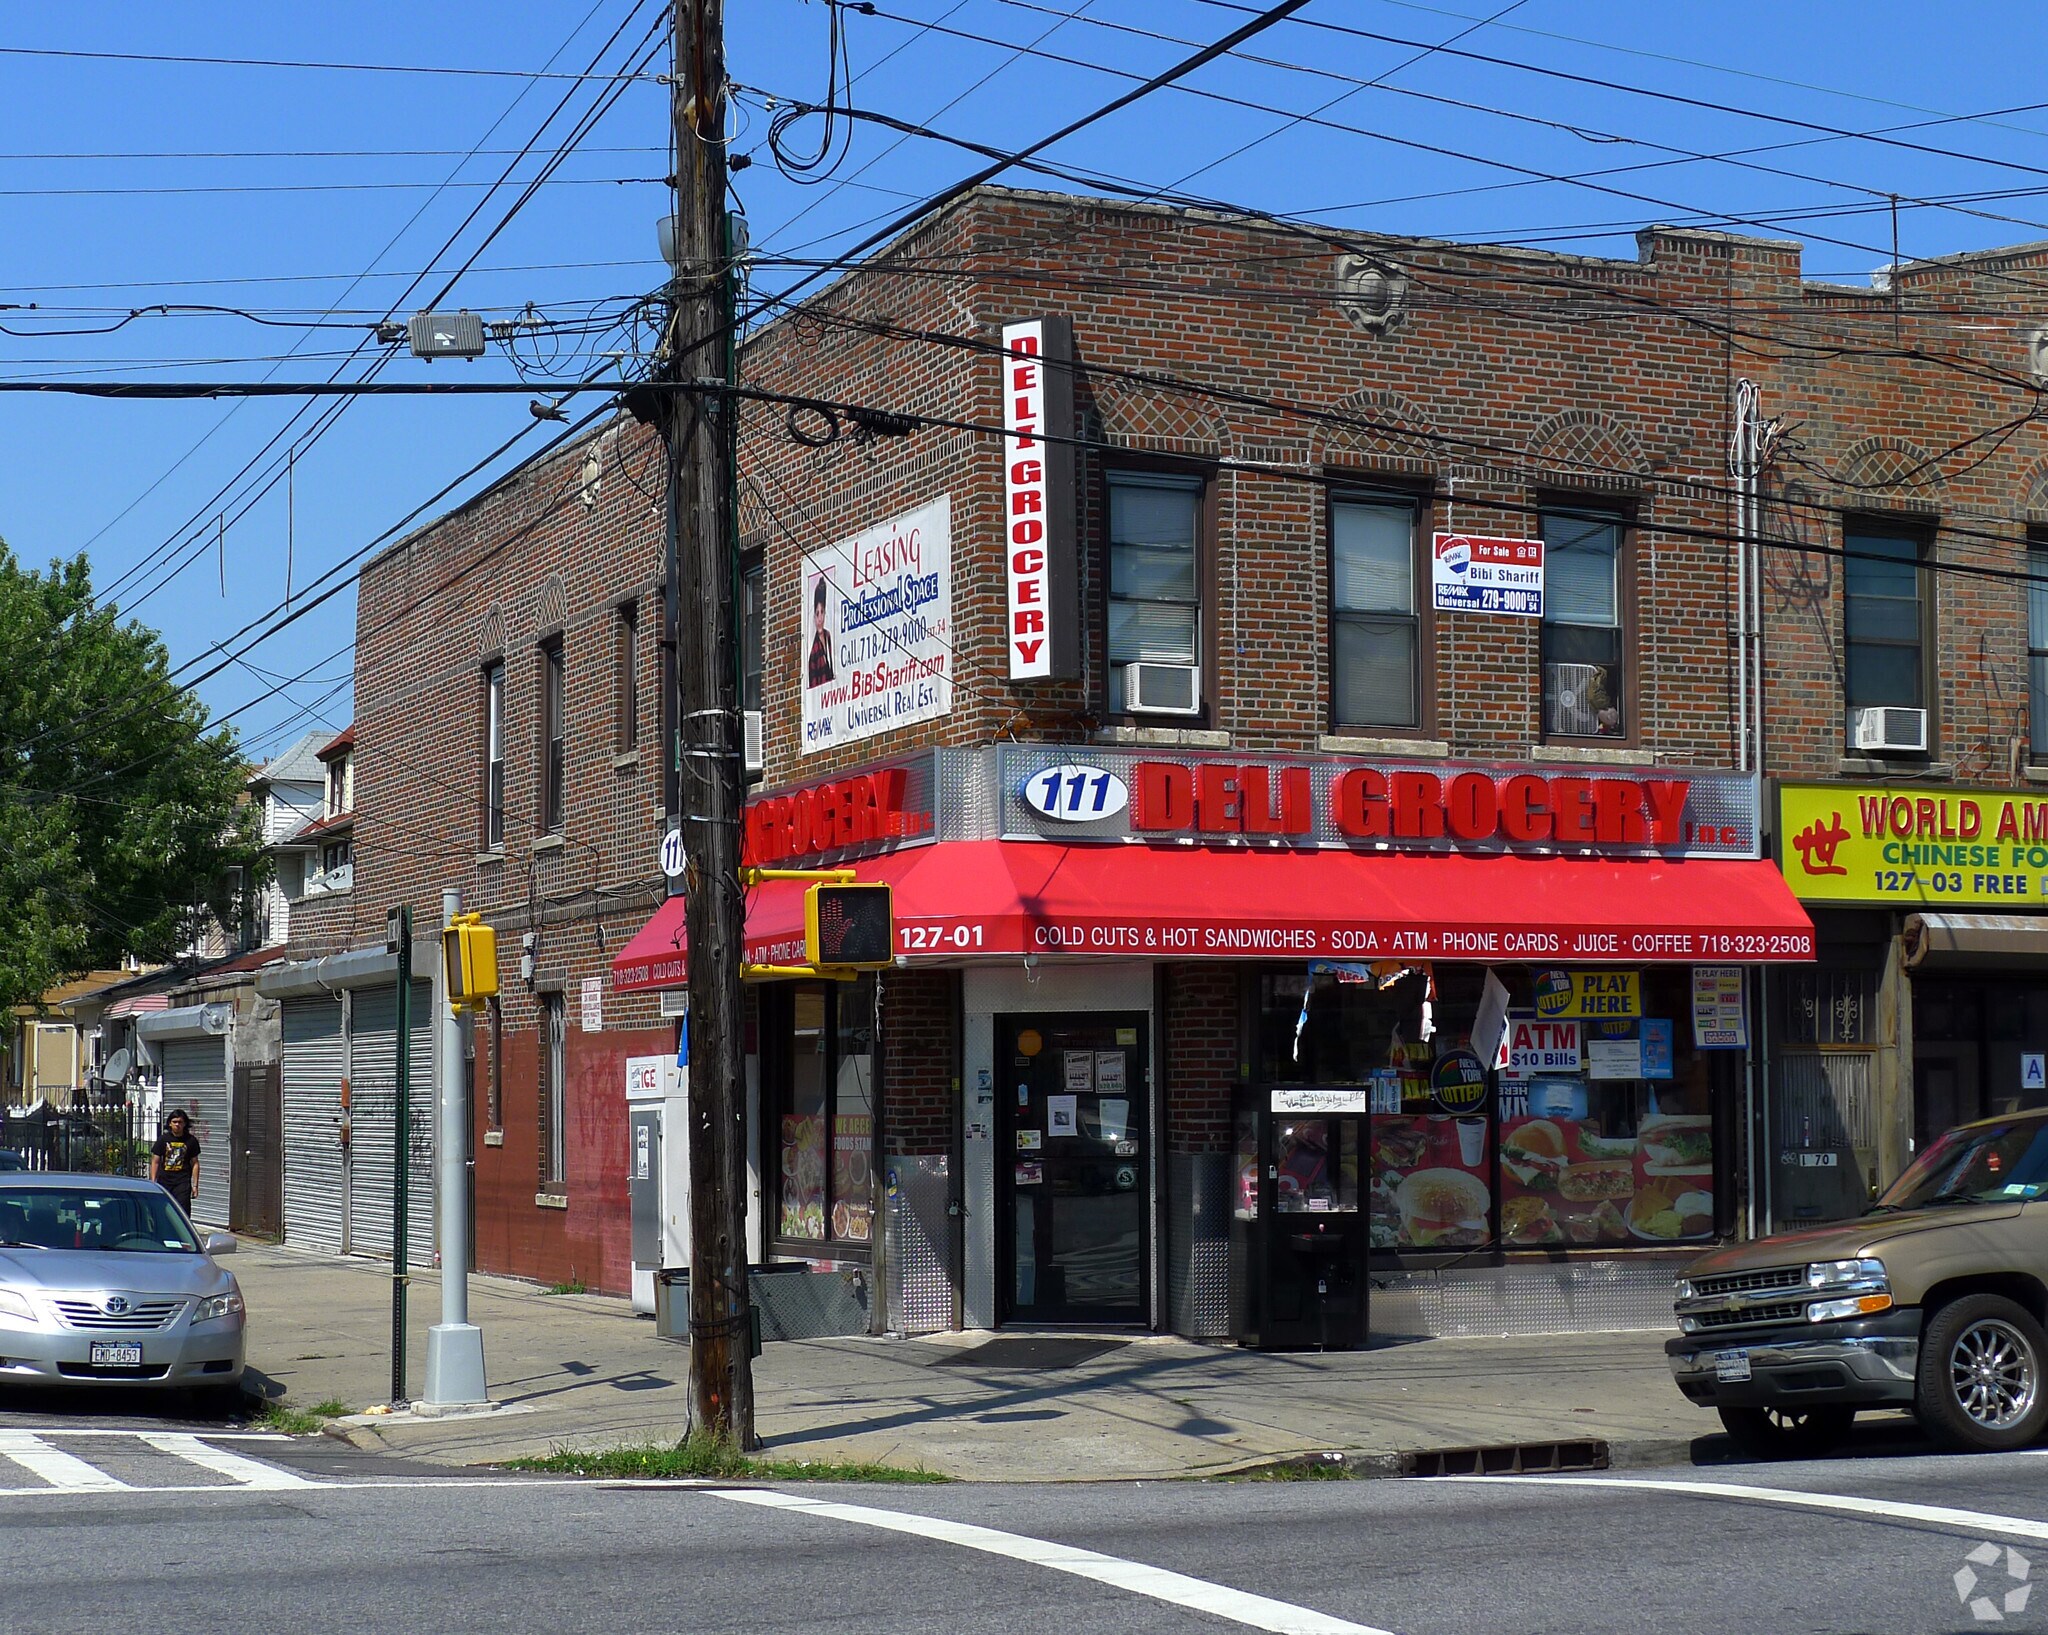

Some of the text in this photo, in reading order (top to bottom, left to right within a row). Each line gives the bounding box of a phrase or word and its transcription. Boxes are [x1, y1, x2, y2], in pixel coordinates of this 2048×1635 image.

[1010, 336, 1037, 450] DELI
[1479, 545, 1509, 557] For Sale
[1010, 460, 1044, 664] GROCERY
[1470, 567, 1539, 584] Bibi Shariff
[1438, 596, 1479, 608] Universal
[1482, 589, 1526, 611] 279-9000
[1041, 772, 1111, 811] 111
[1130, 760, 1748, 845] DELI GROCERY Inc.
[754, 769, 906, 863] GROCERY
[1858, 795, 1982, 839] WORLD
[1882, 843, 2000, 867] CHINESE
[1875, 871, 1963, 893] 127-03
[1974, 874, 2027, 894] FREE
[900, 925, 984, 949] 127-01
[1035, 926, 1085, 946] COLD
[1091, 927, 1139, 946] CUTS
[1145, 928, 1157, 947] &
[1162, 928, 1199, 947] HOT
[1204, 929, 1316, 949] SANDWICHES
[1331, 930, 1379, 949] SODA
[1392, 931, 1428, 950] ATM
[1442, 932, 1499, 951] PHONE
[1504, 933, 1559, 952] CARDS
[1573, 934, 1618, 952] JUICE
[1632, 934, 1692, 953] COFFEE
[770, 941, 791, 961] PHONE
[653, 963, 667, 979] COLD
[667, 960, 681, 978] CUTS
[1550, 970, 1566, 979] NEW
[1702, 970, 1718, 978] PLAY
[1552, 979, 1570, 991] YORK
[1584, 975, 1630, 993] PLAY
[1537, 991, 1571, 1010] LOTTERY
[1581, 995, 1632, 1013] HERE
[1513, 1023, 1575, 1049] ATM
[1458, 1057, 1477, 1068] NEW
[1511, 1053, 1538, 1068] $10
[1544, 1052, 1576, 1066] Bills
[2027, 1059, 2042, 1079] A
[641, 1068, 656, 1089] ICE
[1460, 1069, 1482, 1083] YORK
[1439, 1082, 1485, 1104] LOTTERY
[835, 1117, 847, 1135] WE
[834, 1136, 854, 1151] FOODS
